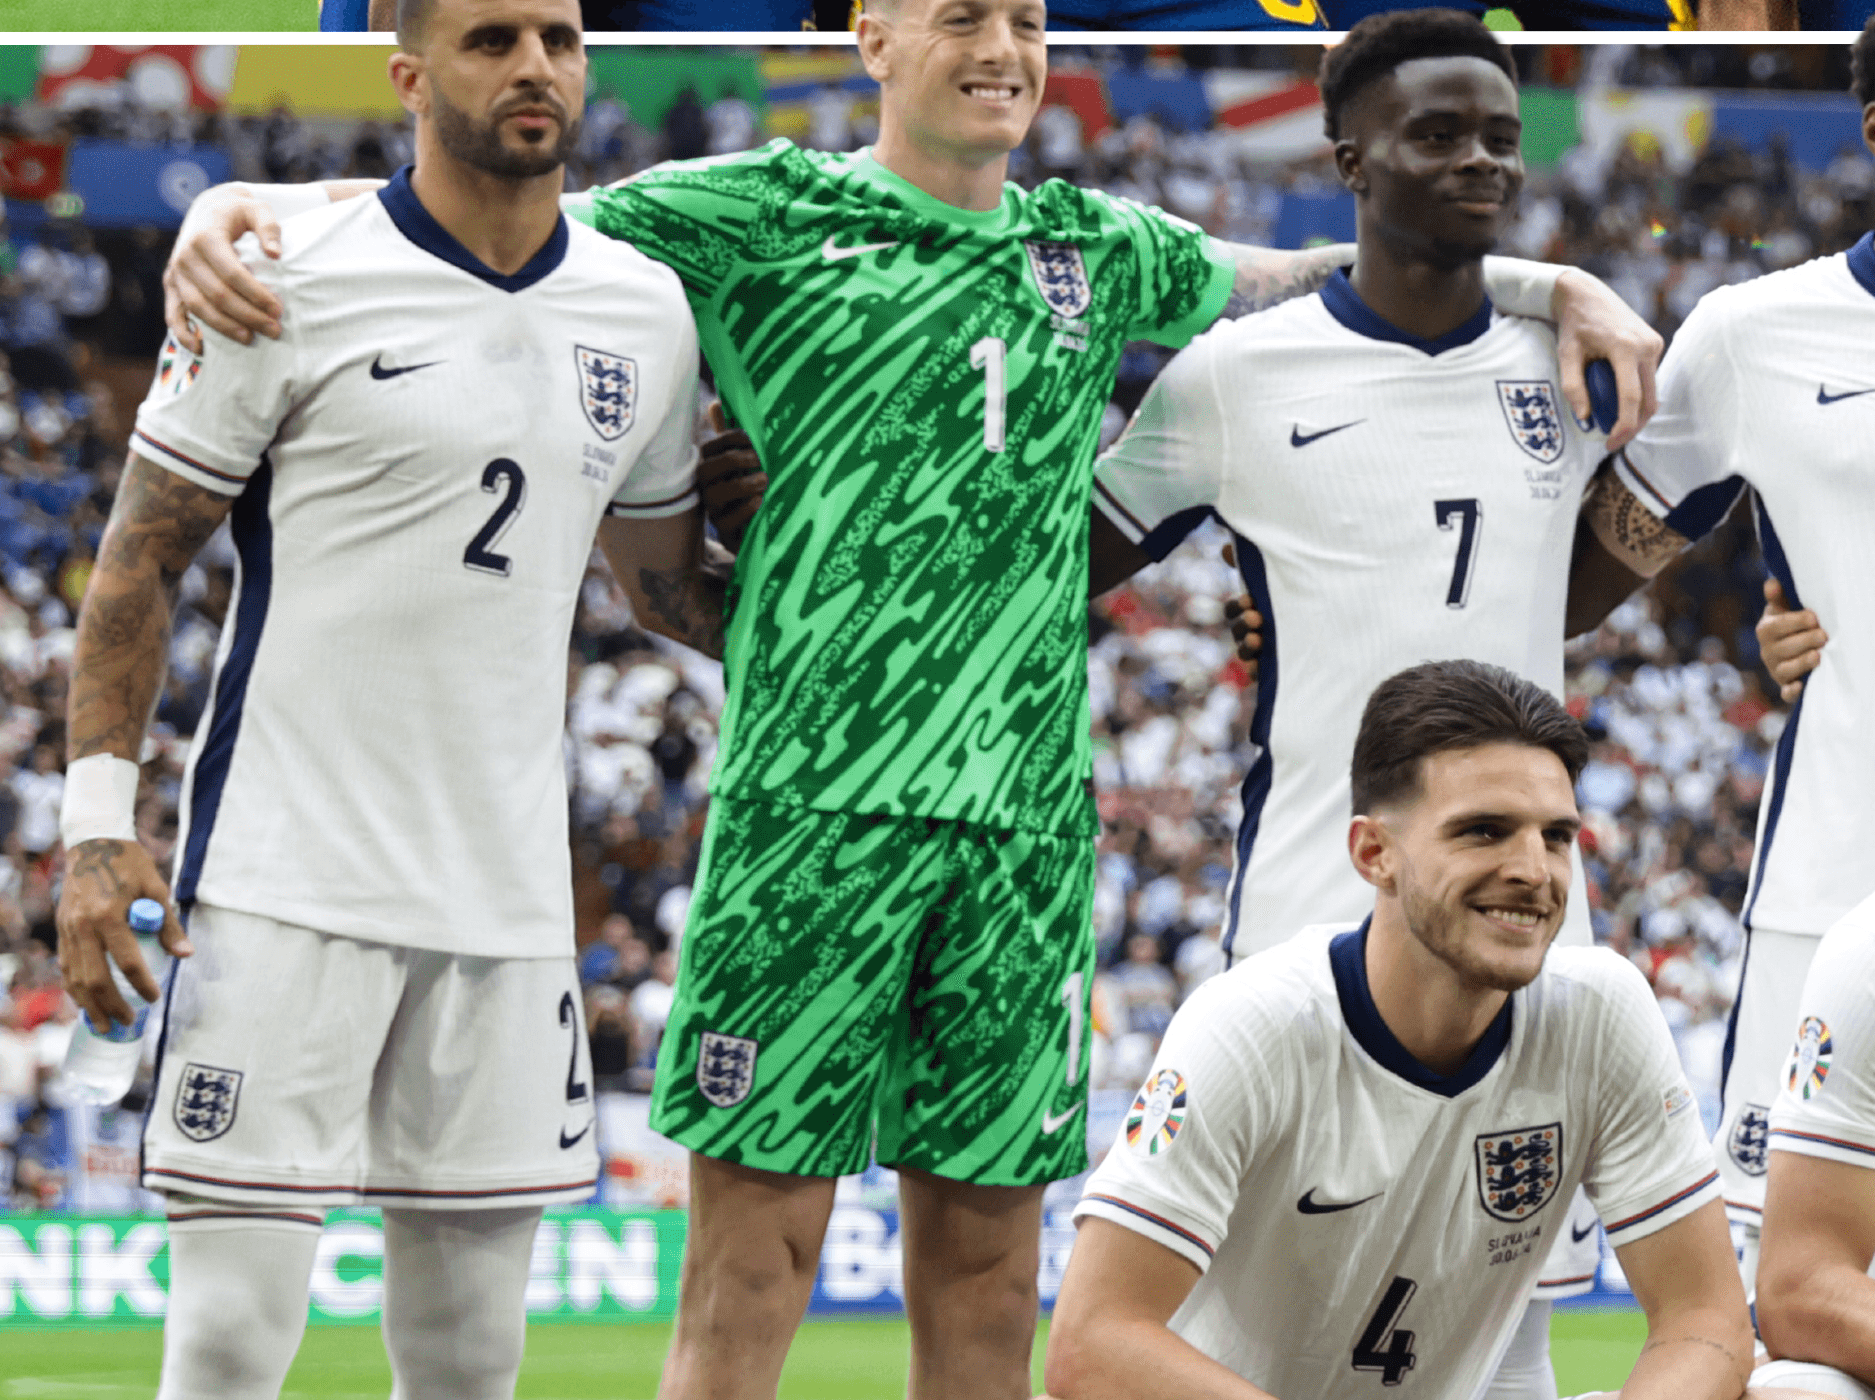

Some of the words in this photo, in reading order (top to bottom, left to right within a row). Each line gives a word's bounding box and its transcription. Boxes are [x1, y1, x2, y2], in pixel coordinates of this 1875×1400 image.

[970, 336, 1007, 453] 1
[463, 457, 529, 578] 2
[1433, 498, 1484, 610] 7
[557, 990, 589, 1107] 2
[1061, 972, 1084, 1087] 1
[1351, 1275, 1418, 1387] 4
